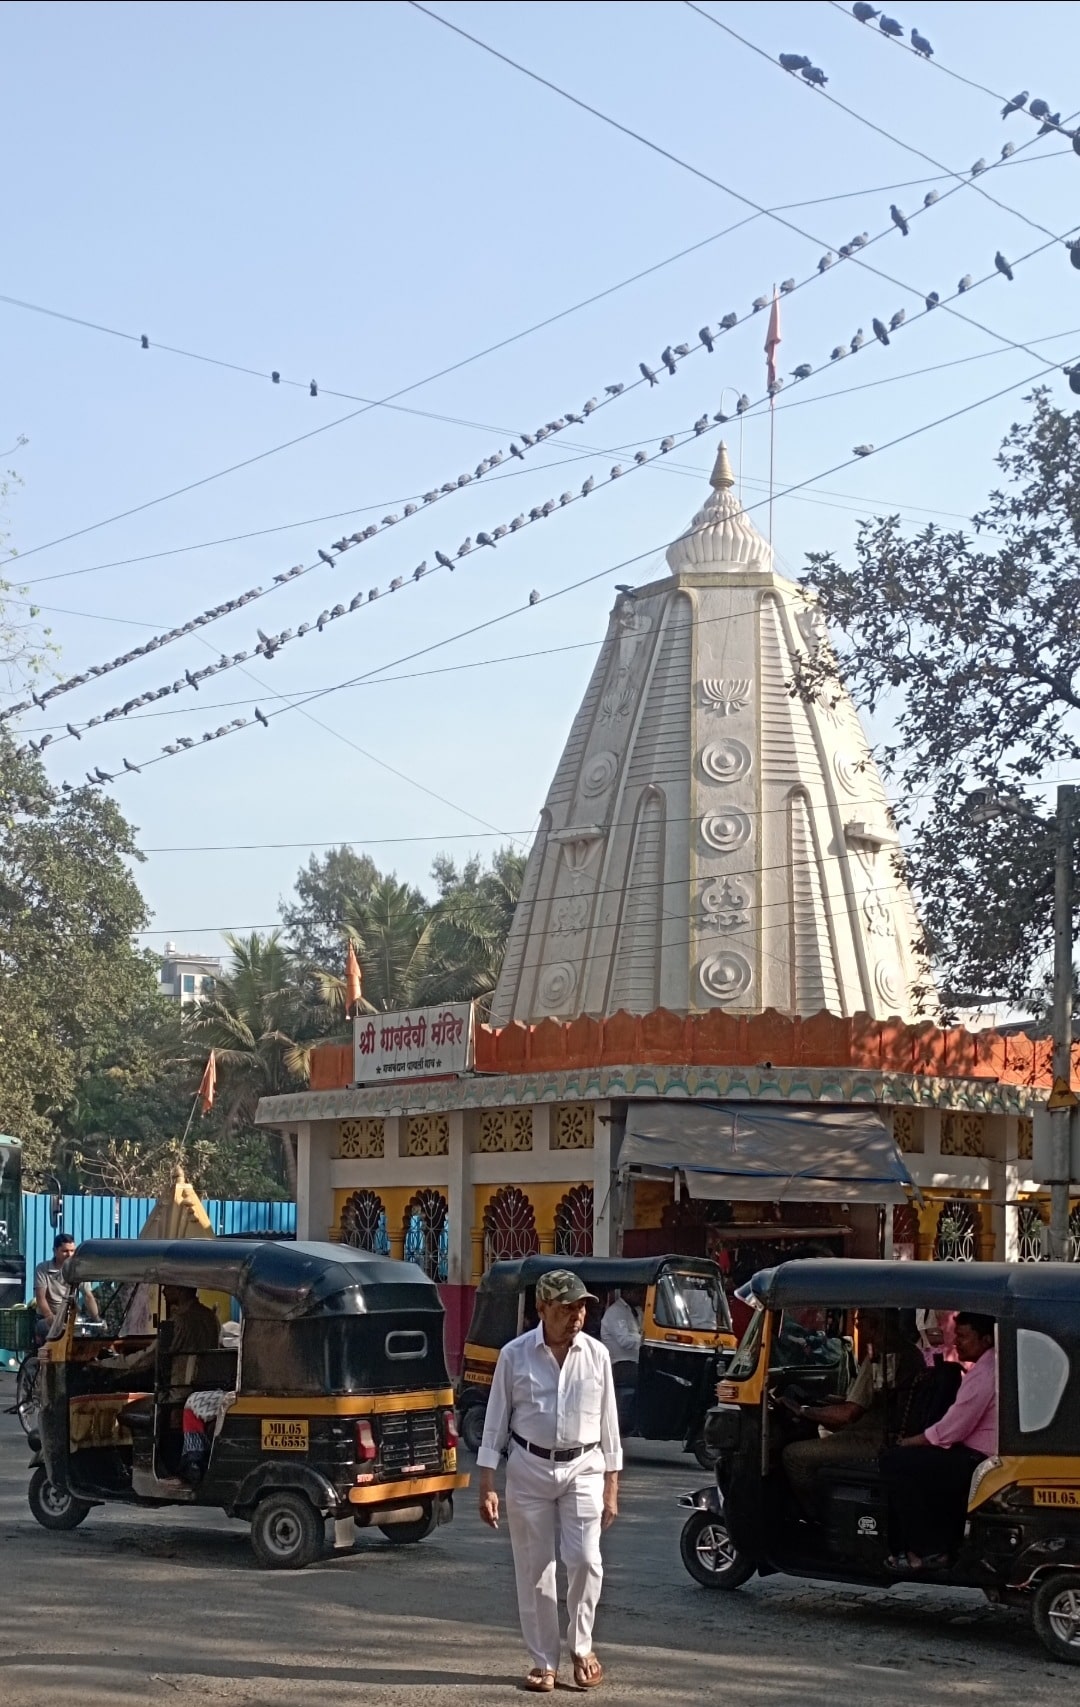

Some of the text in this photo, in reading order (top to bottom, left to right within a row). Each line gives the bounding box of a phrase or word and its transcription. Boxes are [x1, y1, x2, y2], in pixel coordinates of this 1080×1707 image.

[359, 1022, 376, 1055] श्री
[431, 1012, 463, 1046] मंदिर
[269, 1423, 302, 1435] MH.05
[264, 1436, 306, 1448] CG.6555
